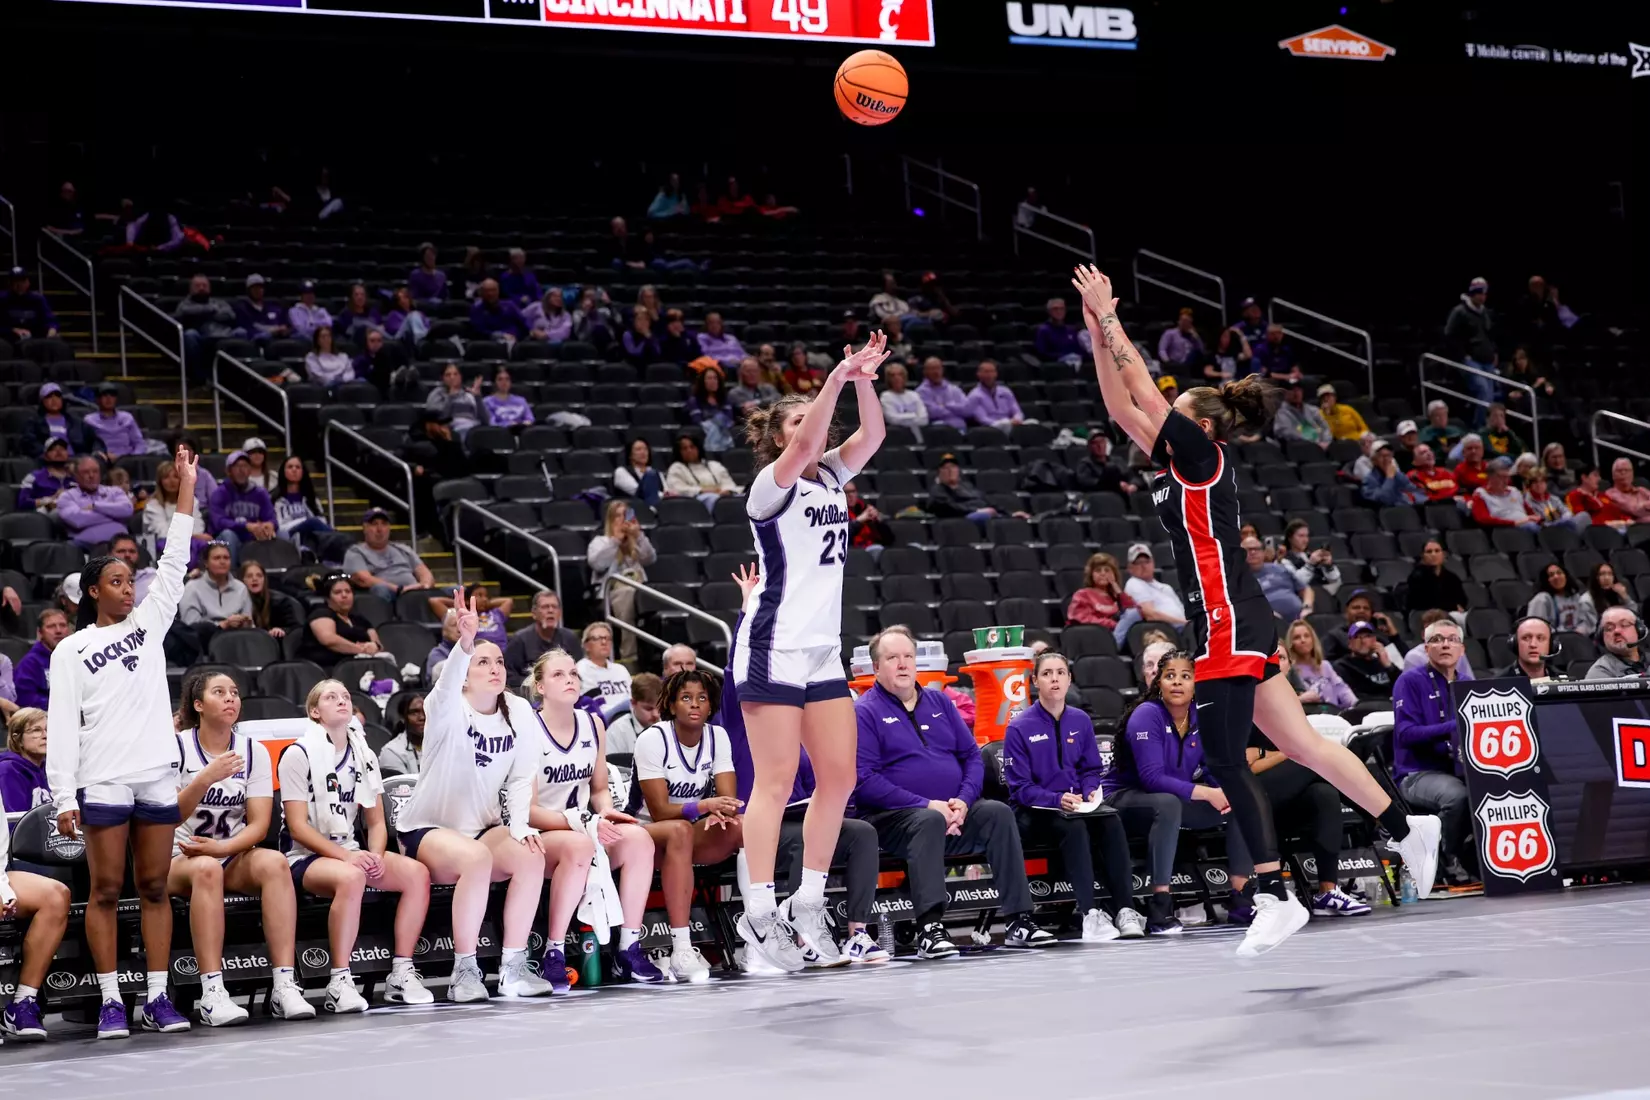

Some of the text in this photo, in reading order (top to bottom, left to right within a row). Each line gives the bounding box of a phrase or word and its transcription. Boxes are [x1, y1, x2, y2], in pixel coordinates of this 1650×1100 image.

[771, 0, 829, 33] 49
[1006, 2, 1137, 40] UMB
[1303, 38, 1370, 55] SERVPRO
[1564, 50, 1596, 65] Home
[1598, 52, 1609, 65] of
[1610, 52, 1628, 67] the
[856, 92, 899, 114] Wilson
[819, 528, 847, 566] 23
[1557, 685, 1579, 693] OFFICIAL
[1580, 684, 1596, 692] GLASS
[1596, 683, 1619, 691] CLEANING
[1619, 682, 1640, 690] PARTNER
[1471, 702, 1522, 719] PHILLIPS
[1479, 725, 1523, 760] 66
[565, 784, 580, 809] 4
[194, 809, 233, 839] 24
[1487, 803, 1539, 822] PHILLIPS
[1495, 828, 1539, 862] 66
